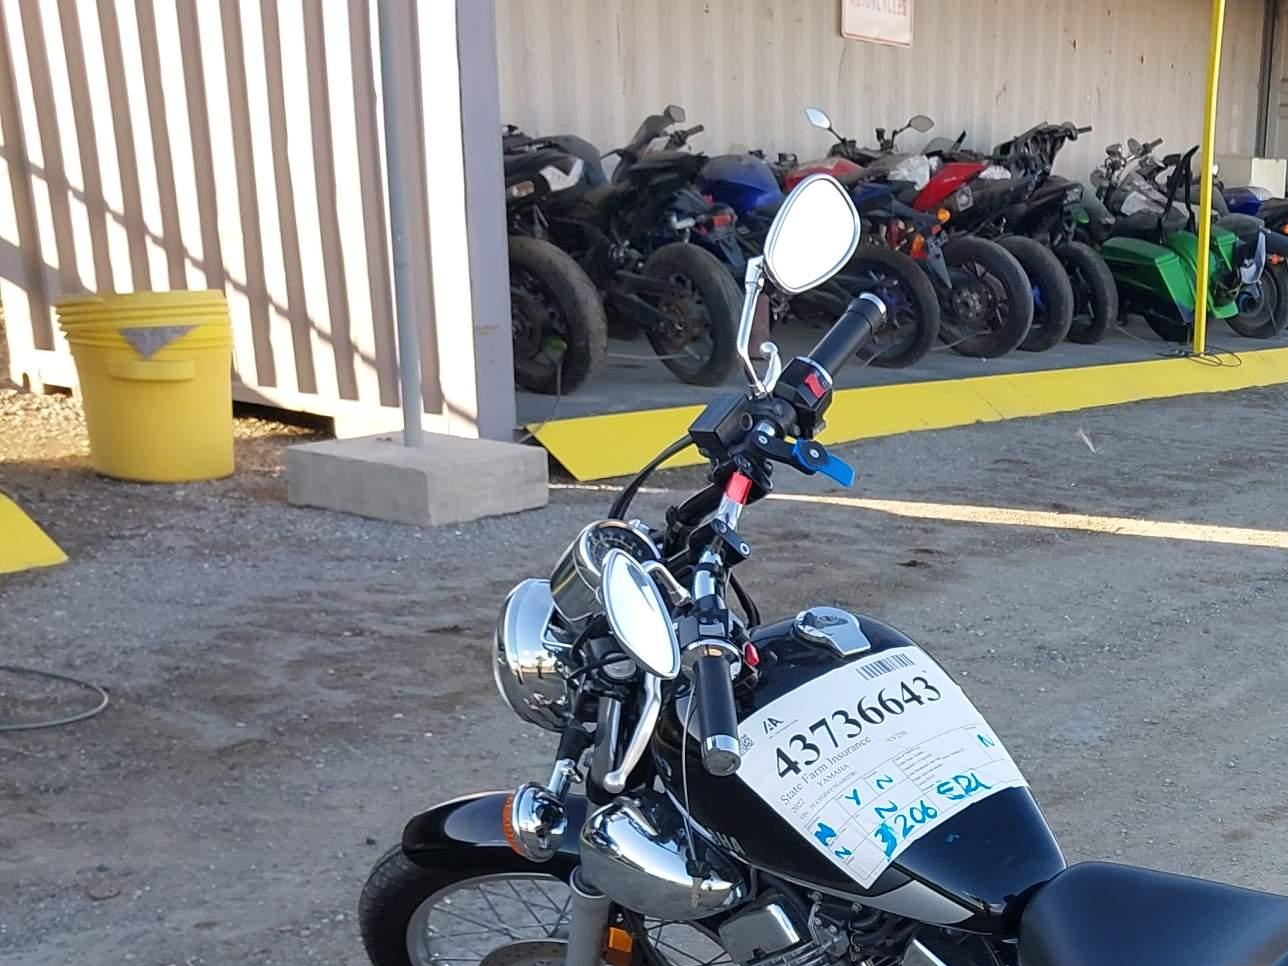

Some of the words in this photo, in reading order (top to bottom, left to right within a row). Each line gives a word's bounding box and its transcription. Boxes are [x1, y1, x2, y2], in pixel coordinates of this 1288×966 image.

[776, 676, 941, 778] 43736643
[780, 781, 803, 805] State
[801, 763, 828, 784] Farm
[826, 735, 872, 766] Insurance
[817, 763, 850, 787] YAMAHA
